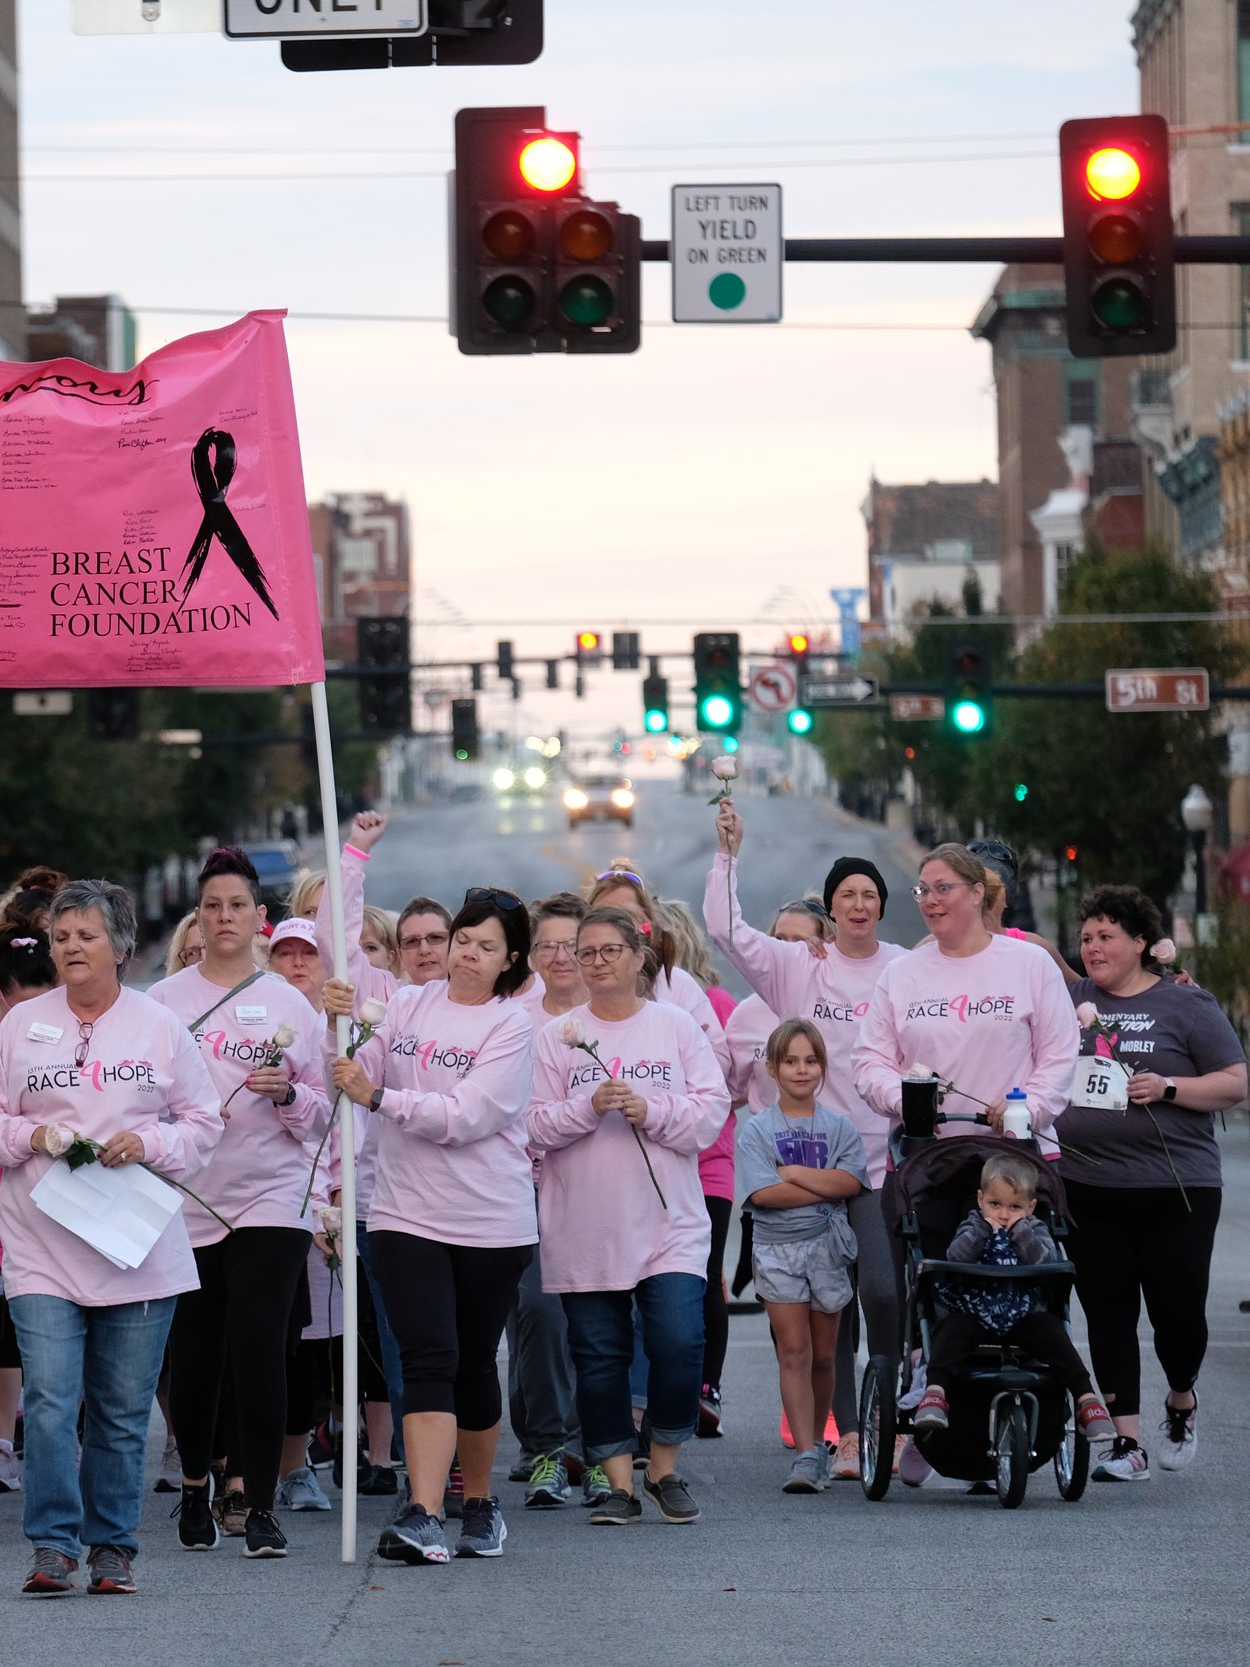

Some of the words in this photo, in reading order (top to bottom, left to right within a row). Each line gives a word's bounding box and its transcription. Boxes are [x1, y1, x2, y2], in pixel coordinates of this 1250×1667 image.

[685, 194, 721, 212] LEFT
[728, 194, 769, 212] TURN
[698, 219, 757, 240] YIELD
[687, 248, 709, 264] ON
[717, 248, 767, 264] GREEN
[50, 547, 171, 576] BREAST
[50, 579, 181, 606] CANCER
[49, 602, 251, 636] FOUNDATION
[1117, 675, 1157, 706] 5th
[1175, 679, 1199, 705] St
[813, 1004, 853, 1022] RACE
[906, 1002, 949, 1021] RACE
[948, 995, 968, 1023] 4
[968, 1000, 1014, 1016] HOPE
[204, 1030, 226, 1061] 4
[416, 1040, 437, 1070] 4
[1120, 1041, 1155, 1053] MOBLEY
[27, 1066, 43, 1074] 13TH
[27, 1070, 80, 1092] RACE
[79, 1060, 104, 1092] 4
[103, 1065, 156, 1084] HOPE
[568, 1067, 602, 1089] ACE
[622, 1065, 671, 1082] HOPE
[137, 1084, 154, 1093] 2022
[652, 1081, 670, 1089] 2022
[1086, 1074, 1111, 1094] 55
